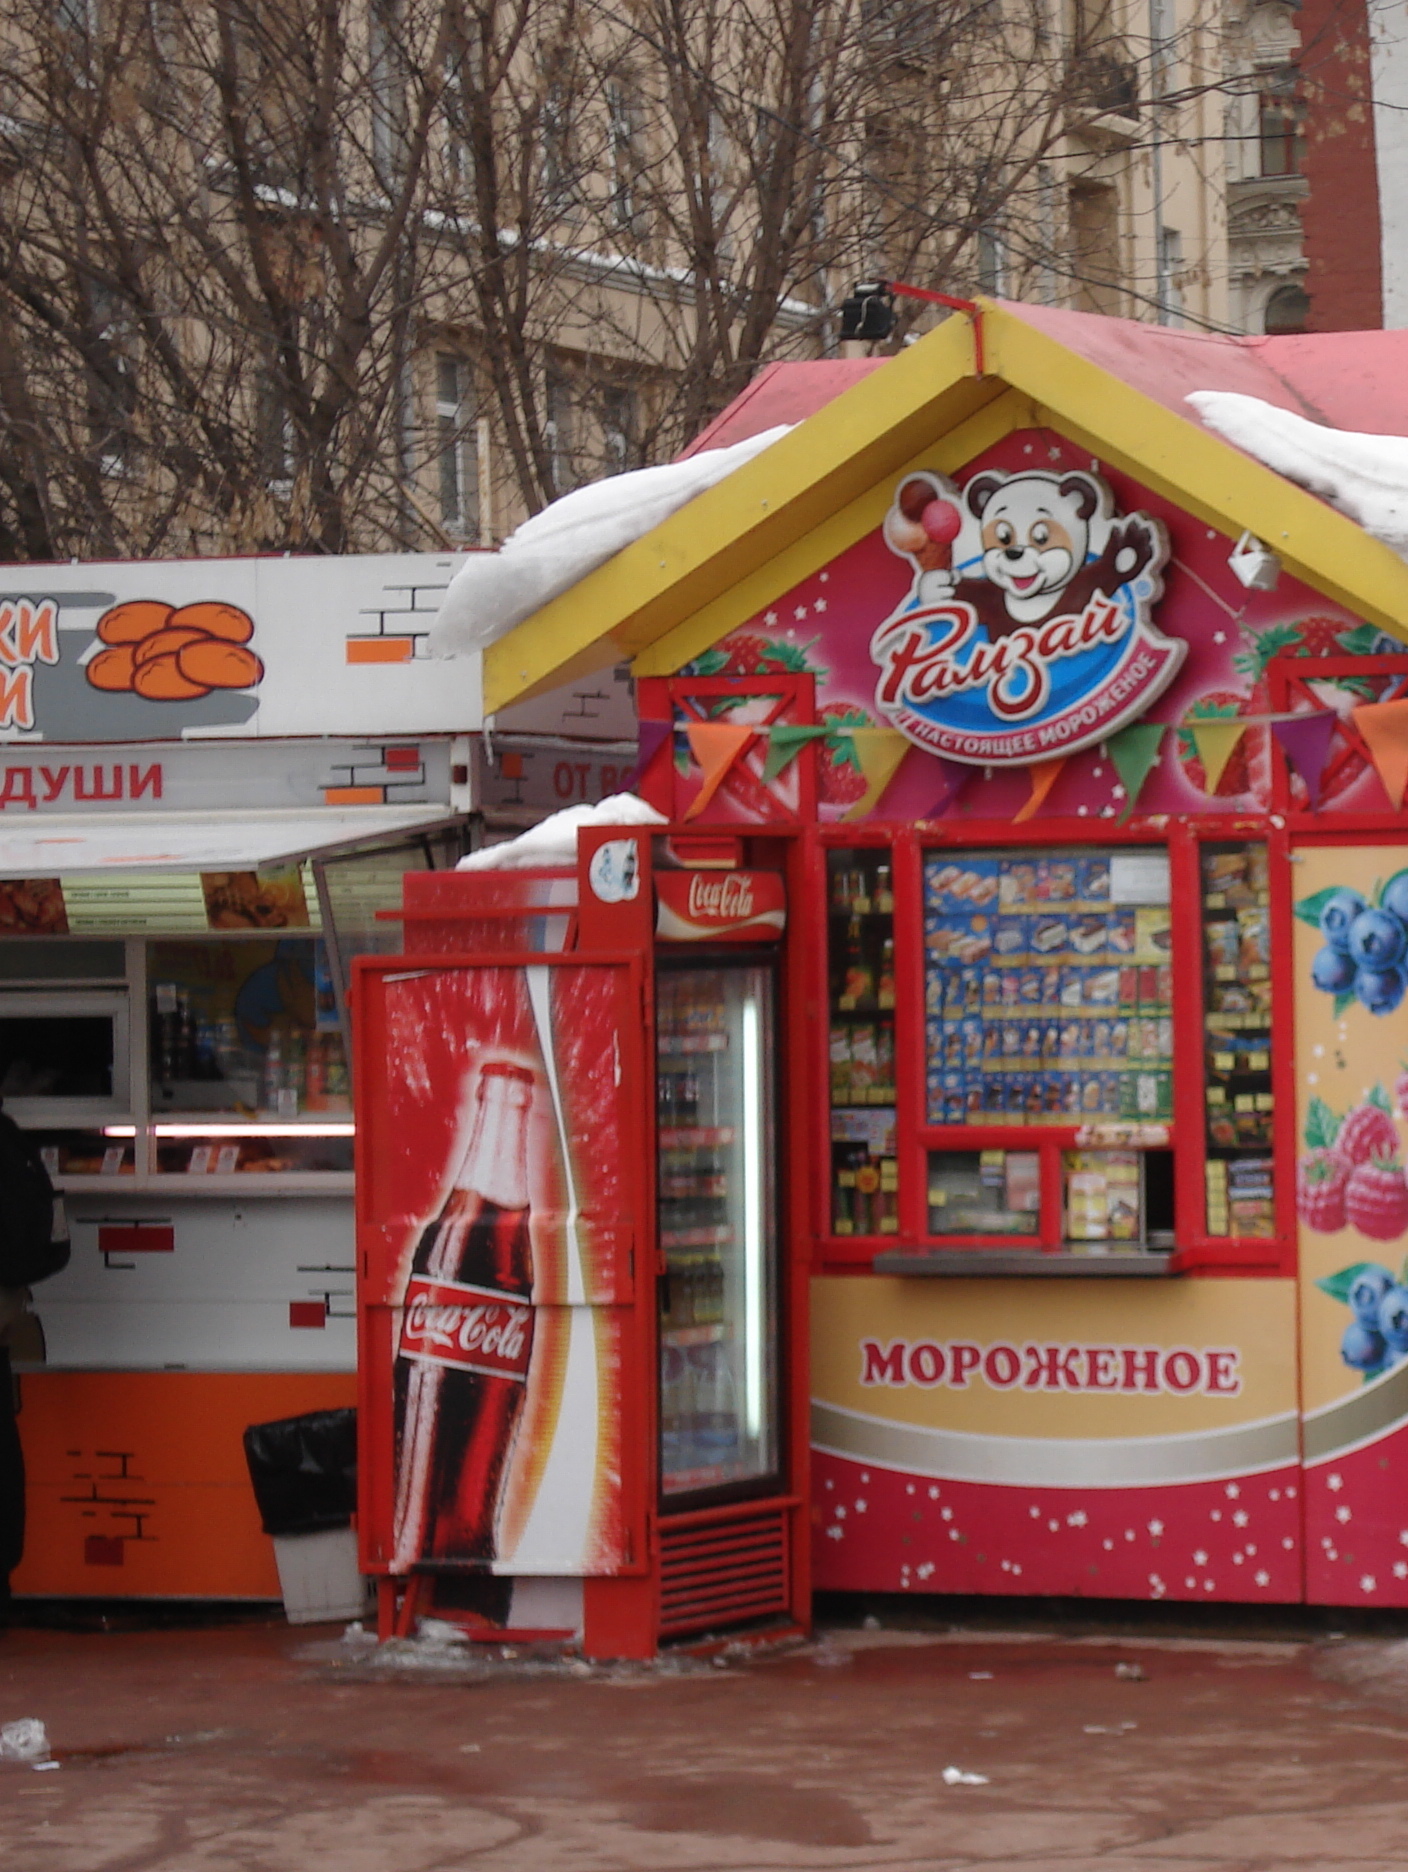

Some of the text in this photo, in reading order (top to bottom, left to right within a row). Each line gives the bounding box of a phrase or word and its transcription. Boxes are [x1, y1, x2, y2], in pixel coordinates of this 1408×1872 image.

[913, 652, 1157, 757] НАСТОЯЩЕЕ МОРОЖЕНОЕ
[0, 763, 163, 810] ДУШИ
[553, 760, 592, 800] ОТ
[404, 1292, 531, 1361] Coca-Cola
[861, 1339, 1242, 1394] МОРОЖЕНОЕ
